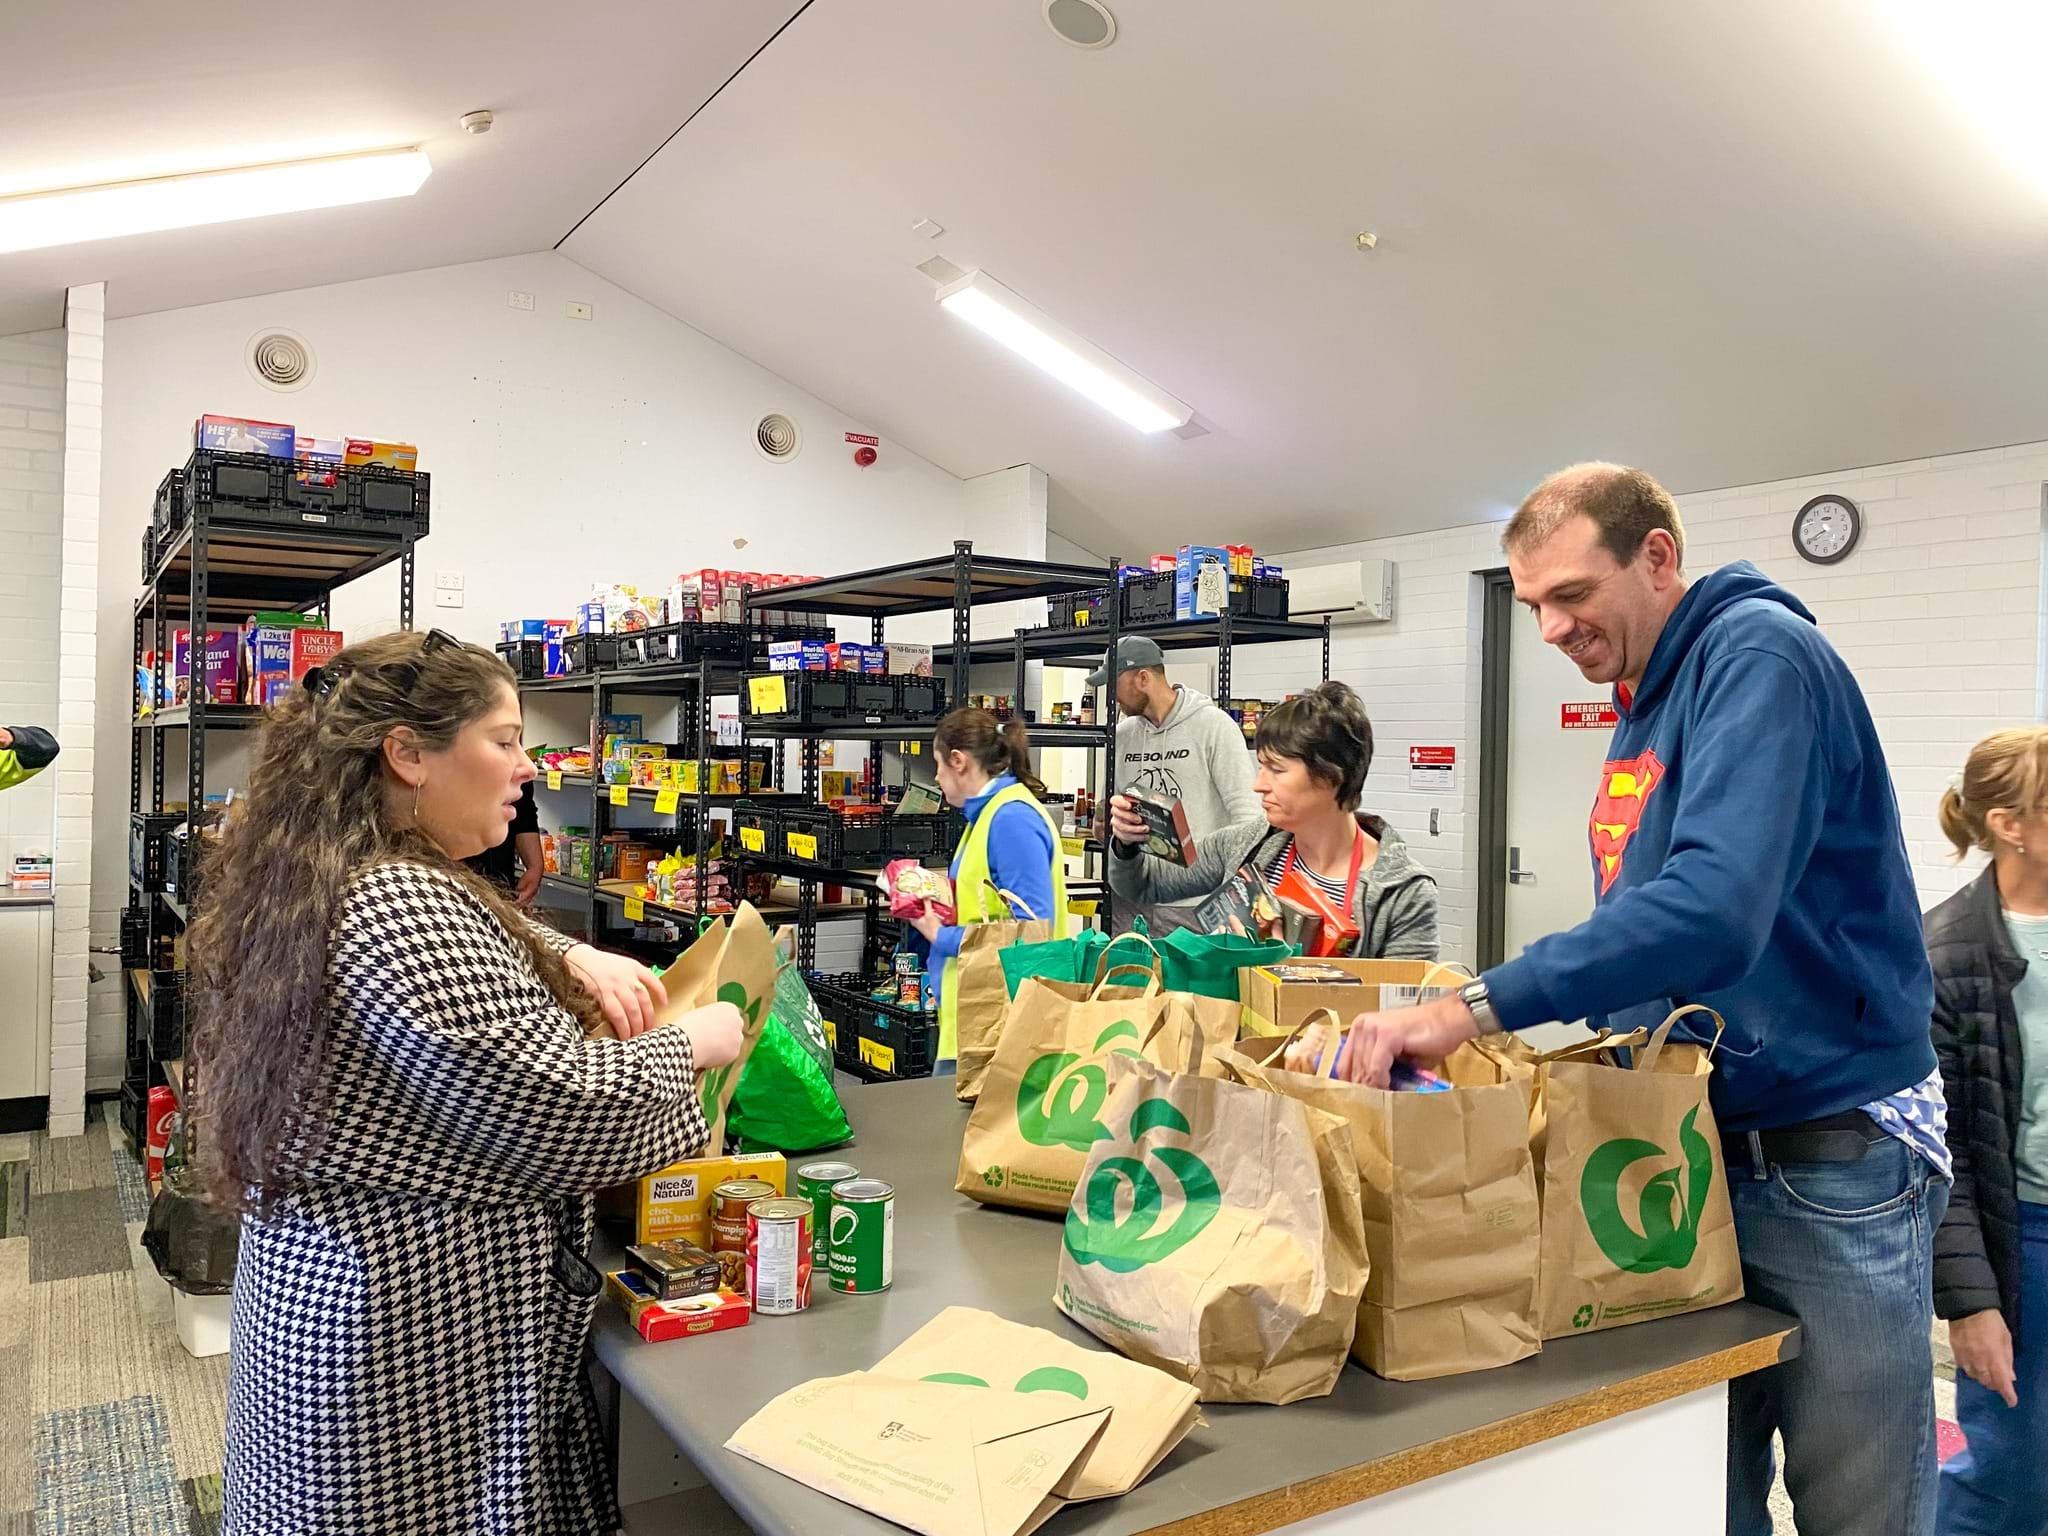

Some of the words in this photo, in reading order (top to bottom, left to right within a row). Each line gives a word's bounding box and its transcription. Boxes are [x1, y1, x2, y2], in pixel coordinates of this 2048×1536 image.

[207, 424, 239, 436] HE'S
[215, 436, 226, 446] A
[845, 434, 879, 446] EVACUATE
[1823, 505, 1831, 513] 12
[1823, 546, 1829, 554] 6
[264, 631, 282, 642] 1.2kg
[301, 634, 337, 645] UNCLE
[301, 645, 337, 654] TOBYS
[769, 656, 801, 672] Weet-Bix
[1581, 712, 1601, 721] EXIT
[1011, 1171, 1029, 1179] Made
[1011, 1178, 1031, 1187] Please
[653, 1187, 694, 1199] Natural
[648, 1206, 673, 1216] choc
[648, 1215, 671, 1225] nut
[672, 1212, 701, 1223] bars
[712, 1221, 747, 1234] Champig
[668, 1280, 700, 1291] MUSSELS
